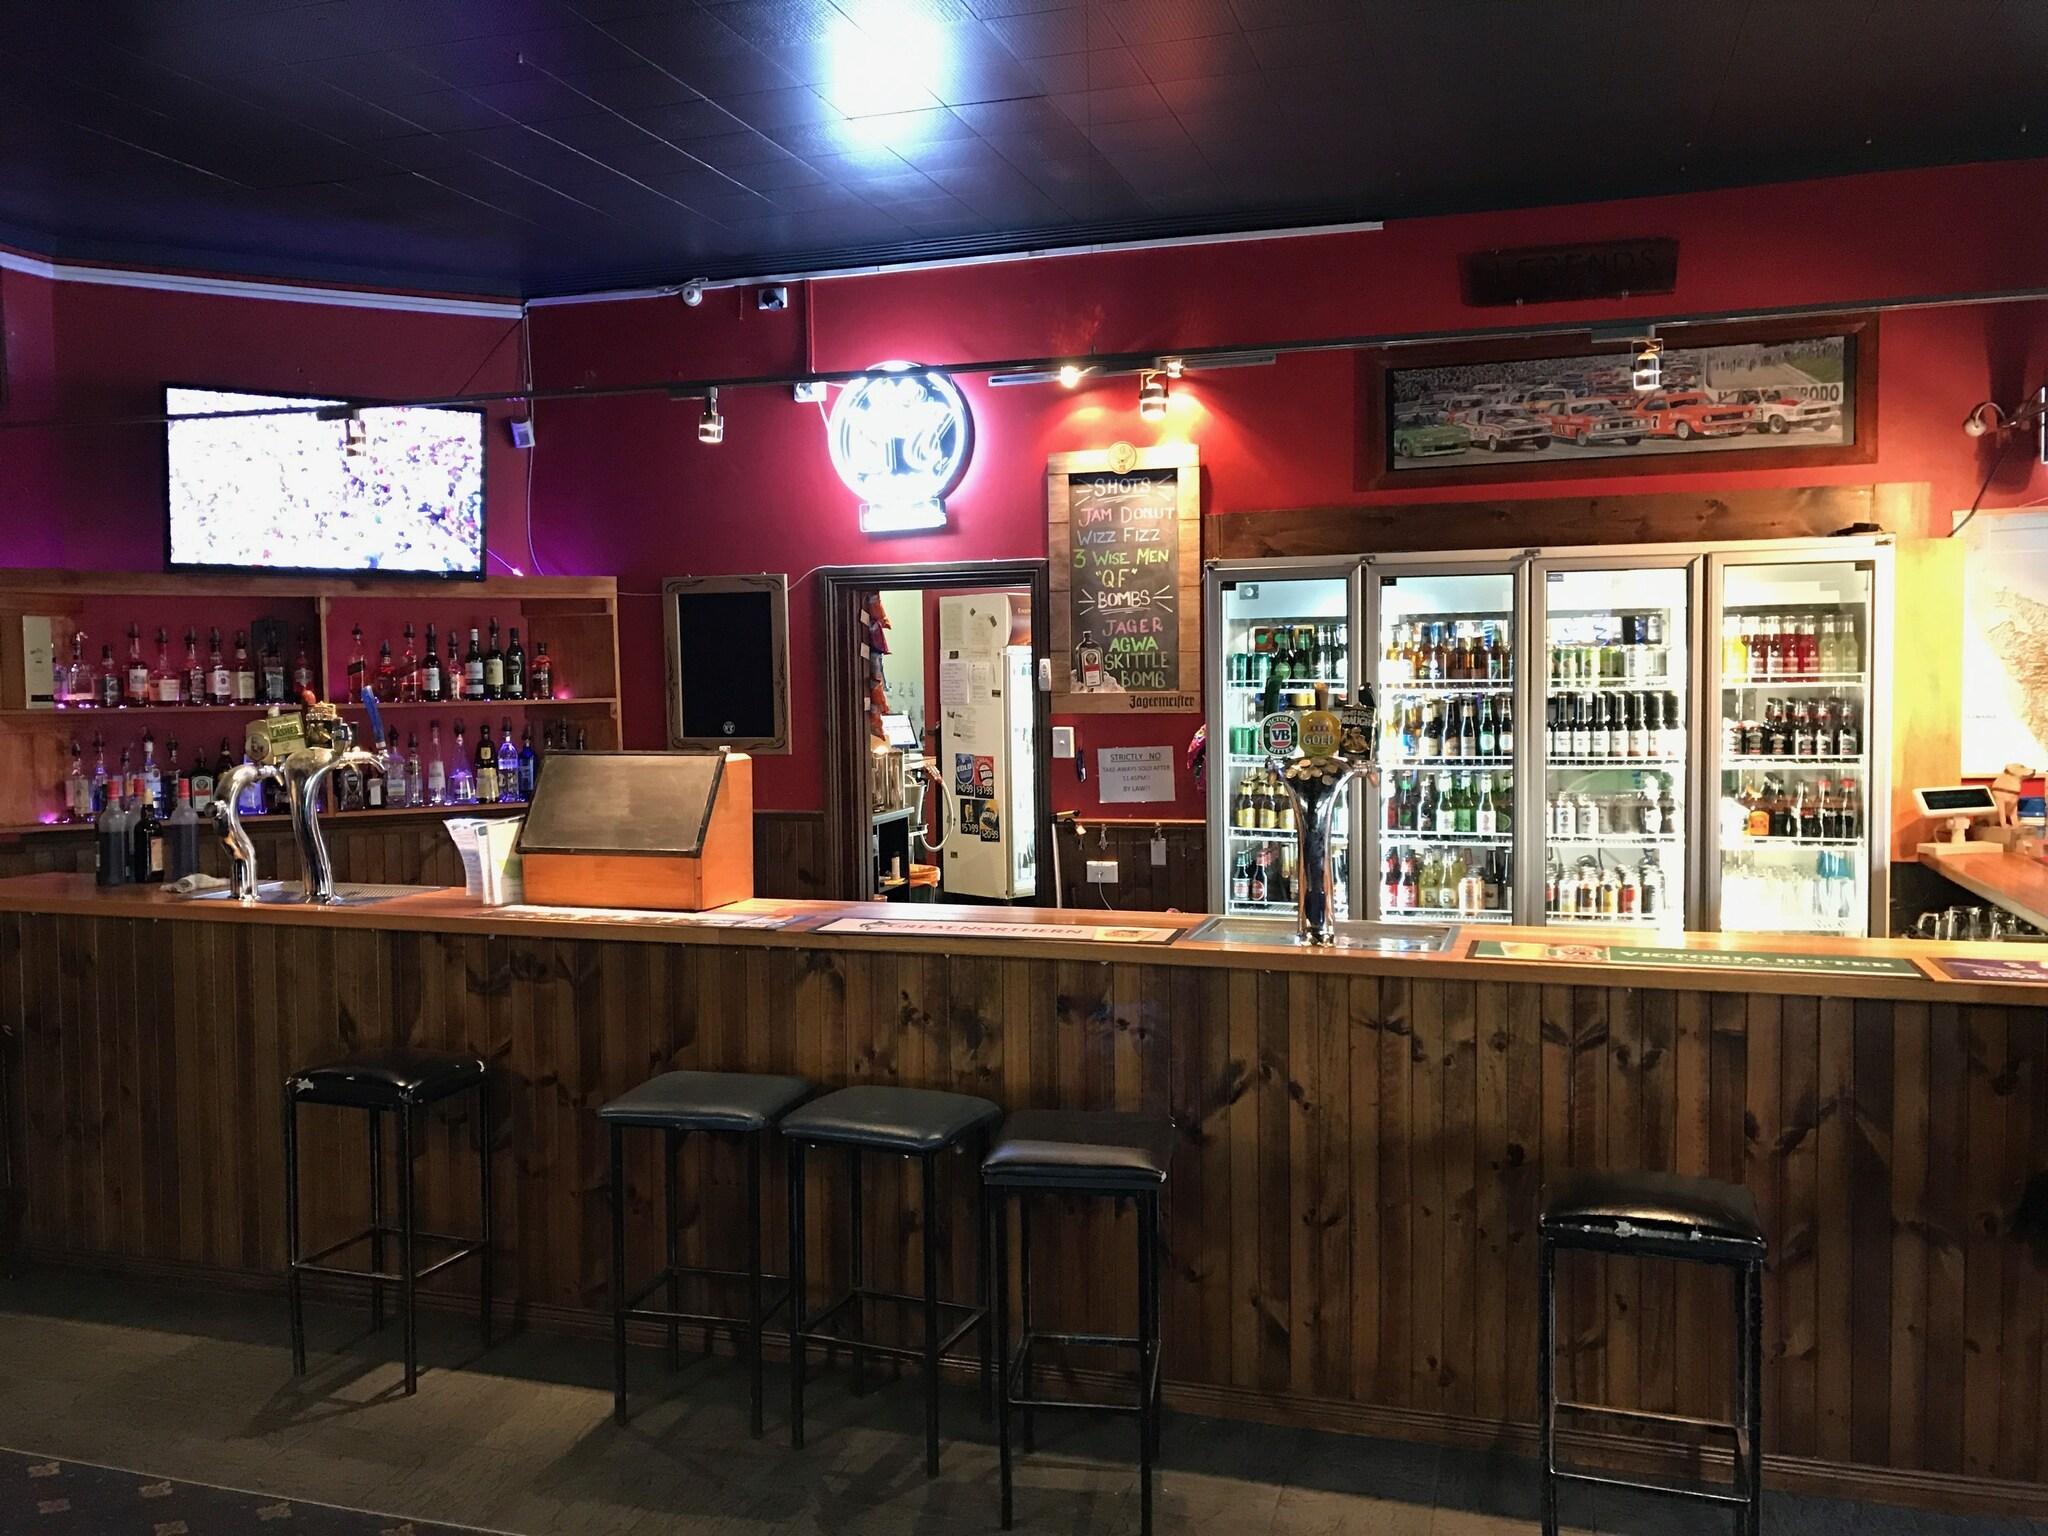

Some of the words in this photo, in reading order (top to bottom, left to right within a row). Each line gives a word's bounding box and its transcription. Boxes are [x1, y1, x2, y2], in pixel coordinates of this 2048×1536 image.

[1652, 415, 1658, 428] 7
[1094, 477, 1151, 496] SHOTS
[1078, 508, 1112, 527] JAM
[1121, 506, 1175, 523] DONUT
[1077, 530, 1116, 546] WIZZ
[1123, 527, 1160, 542] FIZZ
[1073, 549, 1086, 568] 3
[1092, 550, 1130, 566] WISE
[1136, 548, 1169, 565] MEN
[1097, 589, 1151, 609] BOMBS
[1102, 617, 1163, 636] JAGER
[1108, 636, 1159, 652] AGWA
[1104, 651, 1169, 670] SKITTLE
[1121, 671, 1166, 688] BOMB
[1266, 716, 1296, 727] VICTORIA
[1272, 729, 1291, 740] VB
[1303, 734, 1335, 745] GOLD
[1110, 753, 1143, 761] STRICTLY
[1149, 752, 1161, 760] NO
[1269, 745, 1294, 755] BITTER
[957, 763, 972, 772] COLD
[888, 921, 957, 931] GREAT
[960, 926, 1083, 935] NORTHERN
[1619, 950, 1767, 963] VICTORIA
[1775, 957, 1896, 968] BITTER
